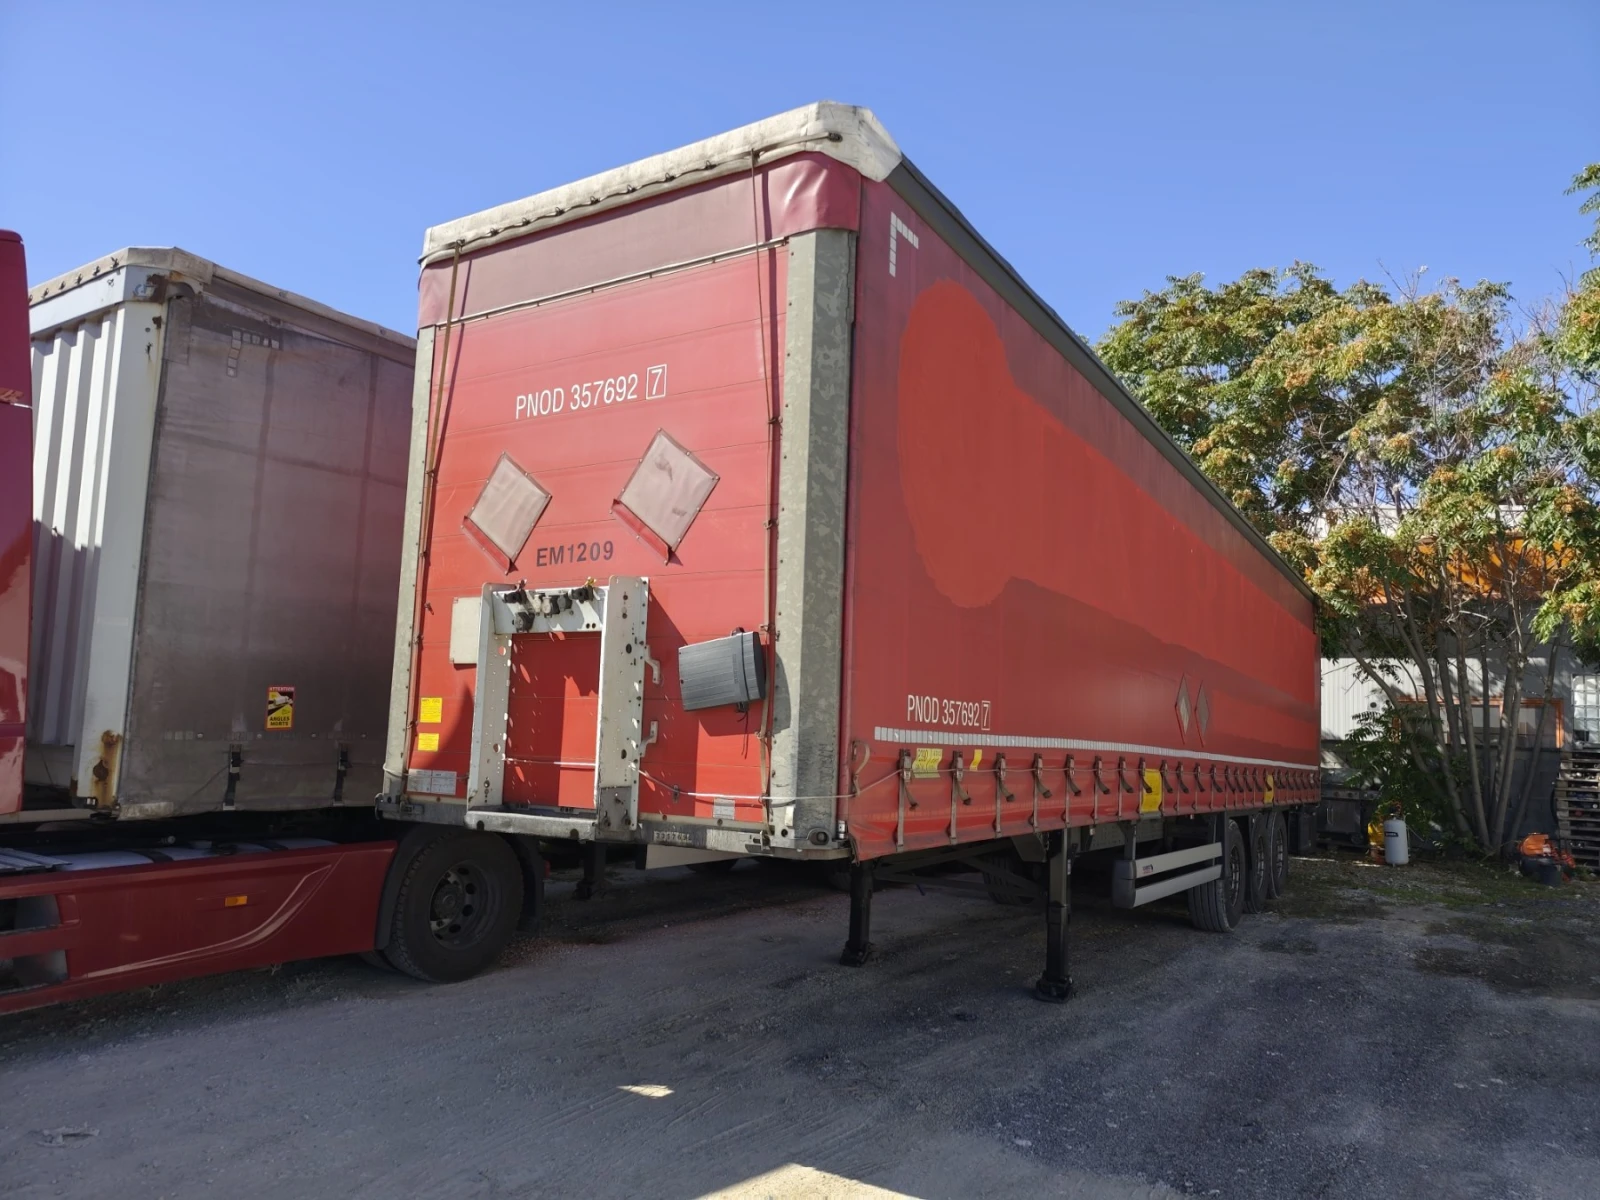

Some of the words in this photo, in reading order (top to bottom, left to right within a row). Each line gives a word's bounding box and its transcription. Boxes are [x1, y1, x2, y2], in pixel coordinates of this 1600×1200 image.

[515, 387, 564, 420] PNOD
[569, 373, 638, 410] 357692
[536, 540, 614, 567] EM1209
[907, 694, 939, 723] PNOD
[942, 699, 980, 726] 357692
